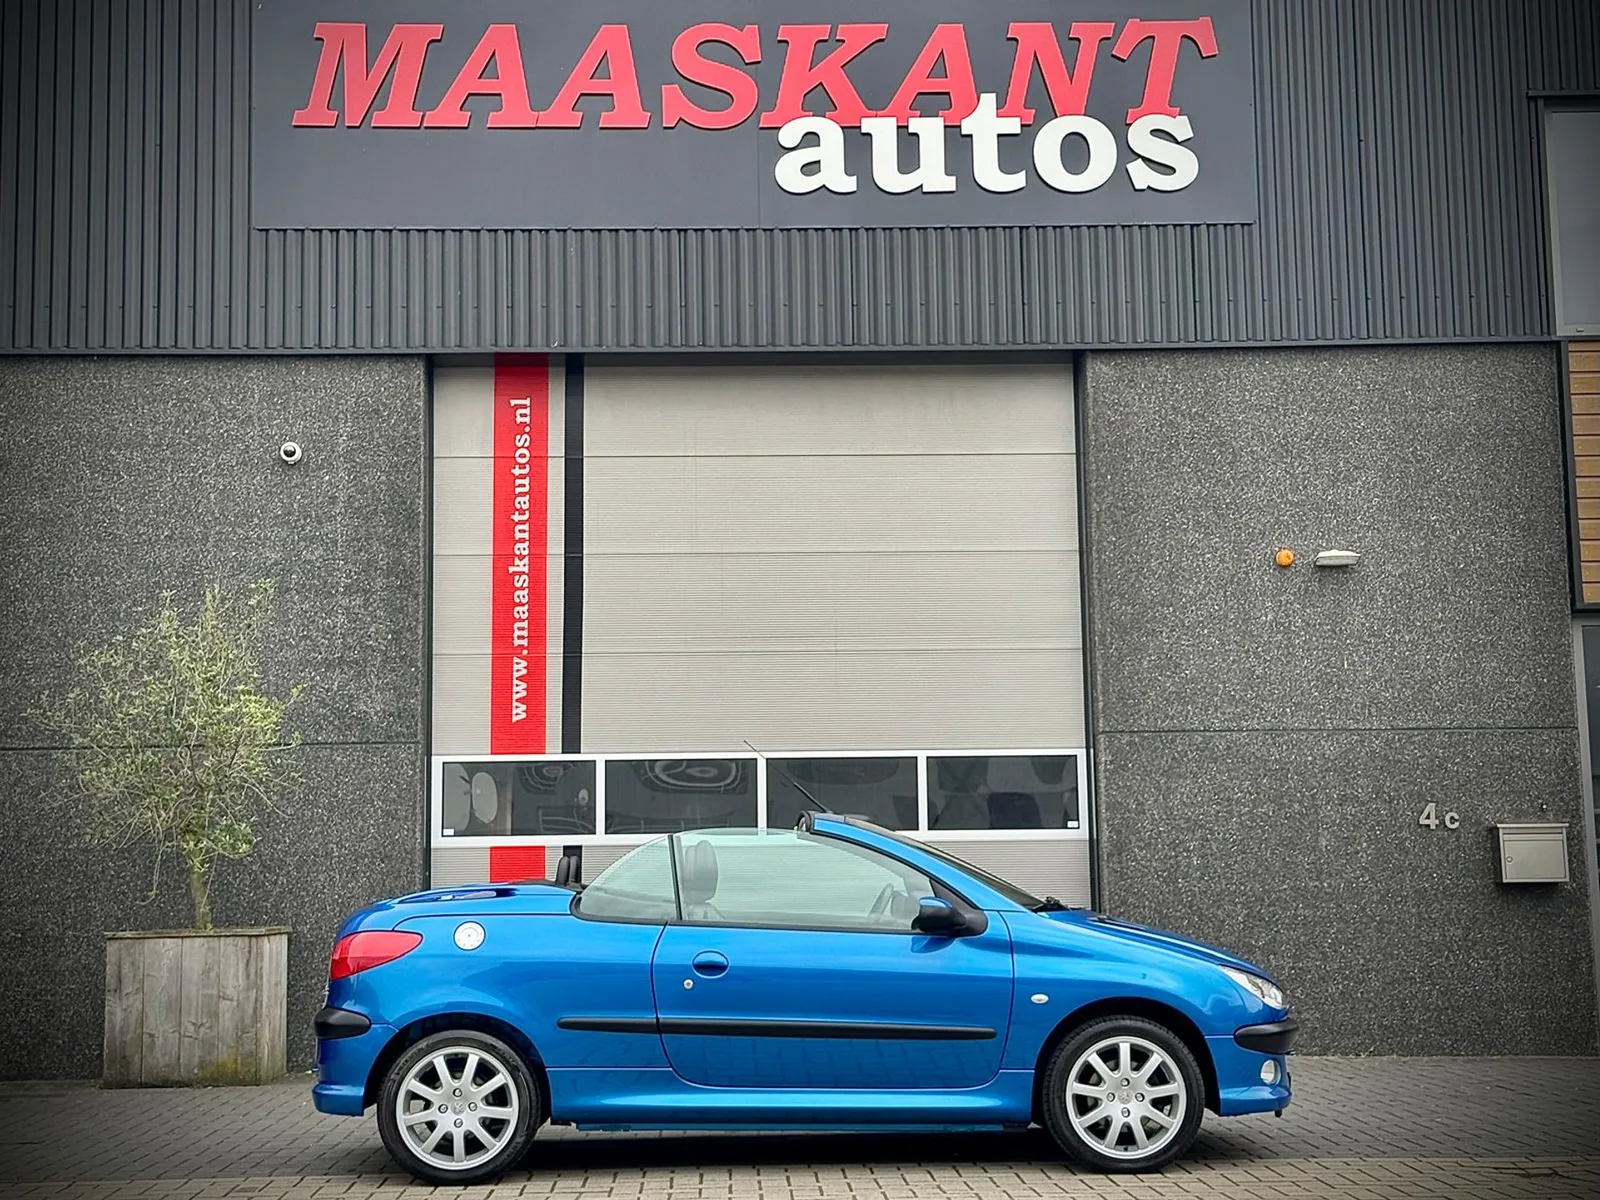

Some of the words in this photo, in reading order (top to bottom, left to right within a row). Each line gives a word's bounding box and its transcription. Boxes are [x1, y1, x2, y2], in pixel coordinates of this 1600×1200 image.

[292, 17, 1219, 129] MAASKANT
[774, 92, 1200, 193] autos
[508, 396, 532, 723] www.maaskantautos.nl
